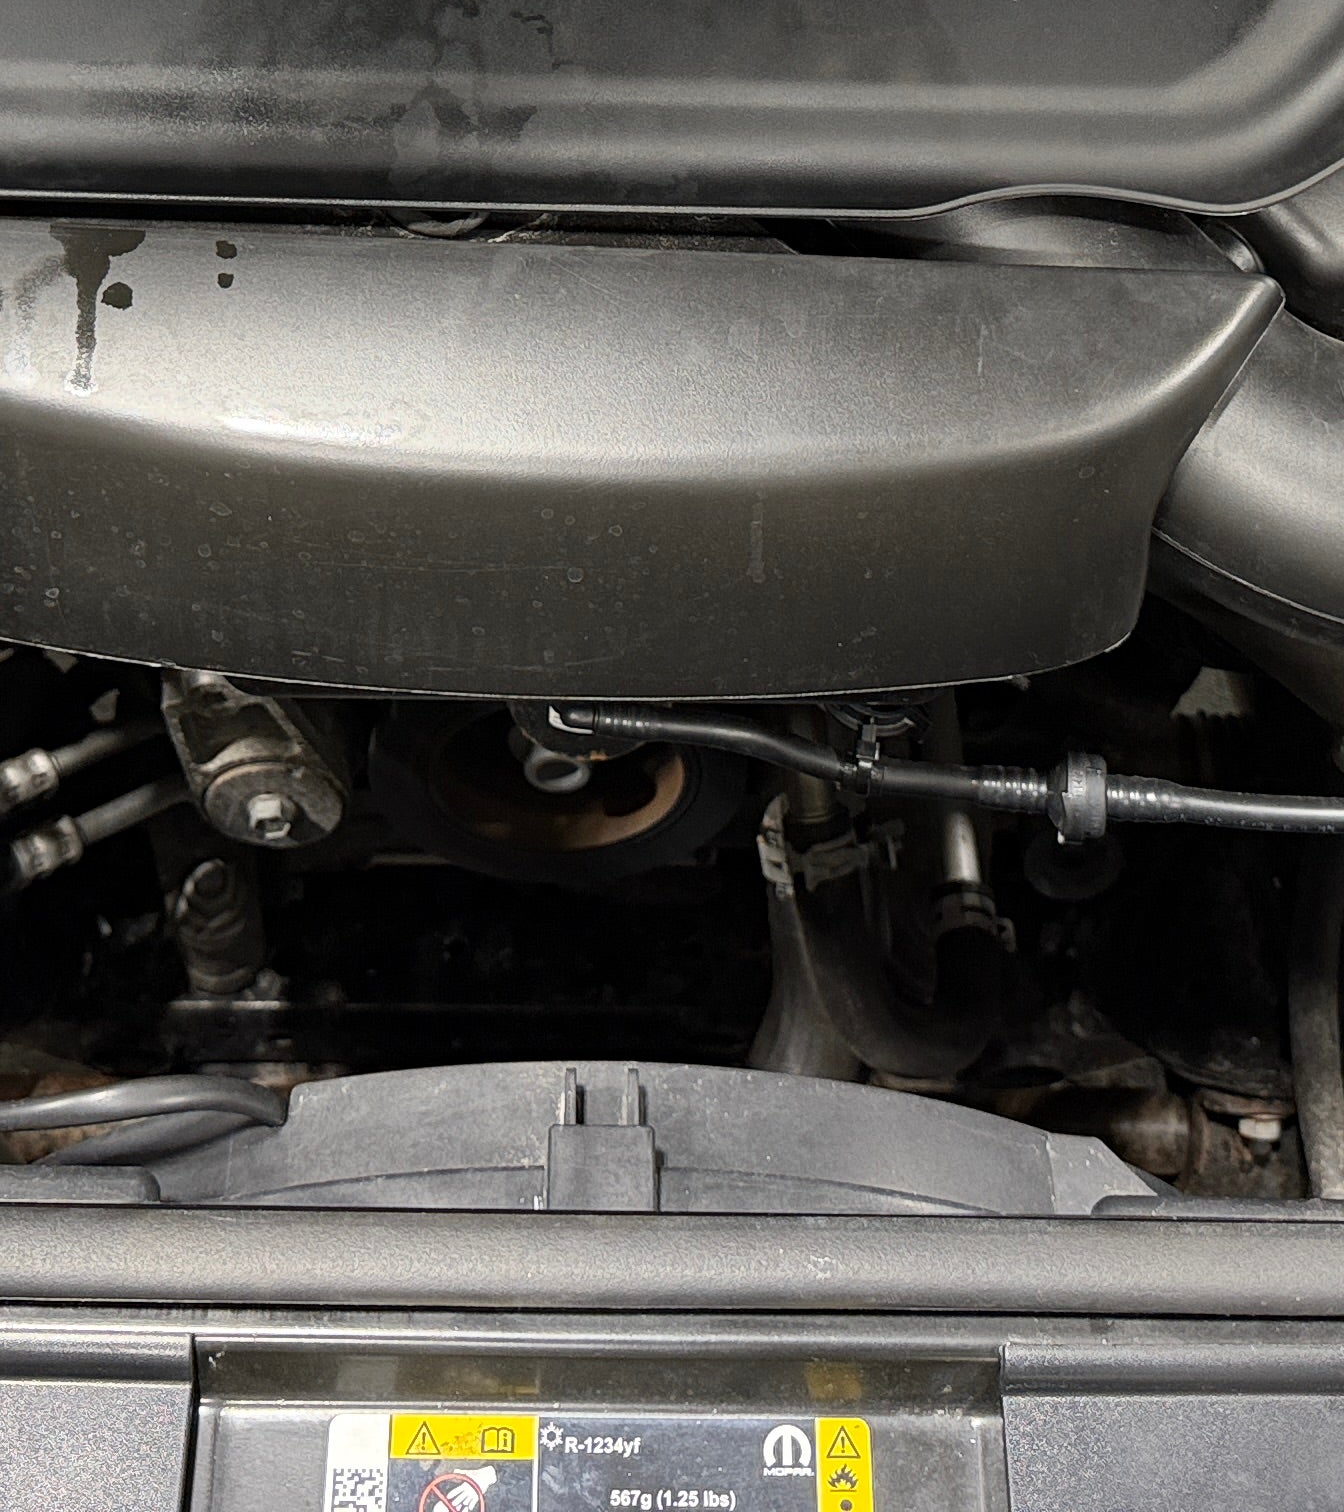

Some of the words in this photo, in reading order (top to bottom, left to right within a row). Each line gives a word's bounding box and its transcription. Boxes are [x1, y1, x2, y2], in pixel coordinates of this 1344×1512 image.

[564, 1438, 641, 1458] R-1234yf
[609, 1490, 653, 1508] 567g
[656, 1490, 700, 1509] (1.25
[703, 1490, 737, 1511] lbs)
